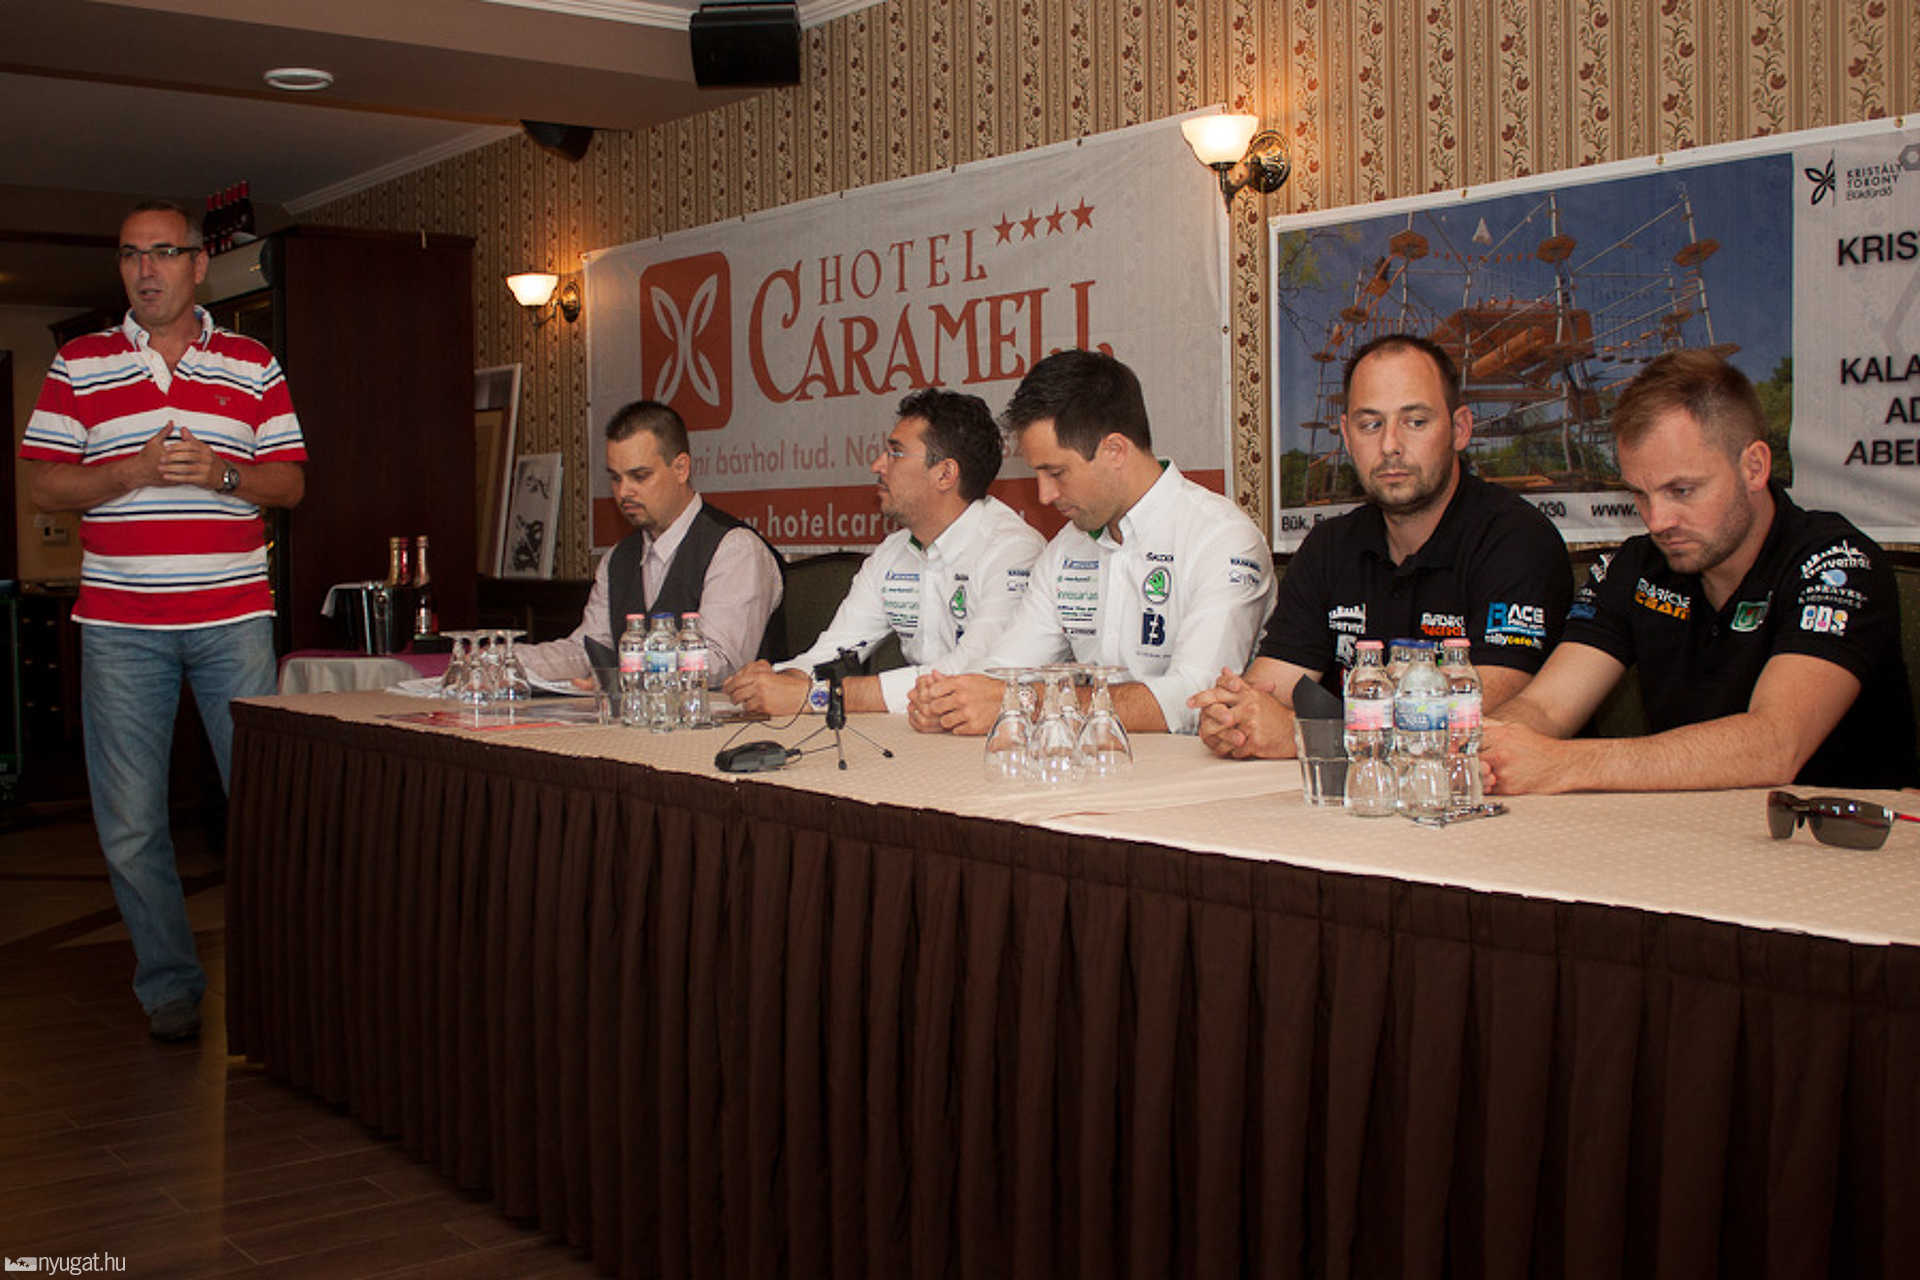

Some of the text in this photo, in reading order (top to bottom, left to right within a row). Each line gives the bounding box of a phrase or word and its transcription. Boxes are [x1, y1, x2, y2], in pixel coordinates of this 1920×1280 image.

[818, 228, 988, 306] HOTEL
[1837, 231, 1920, 267] KRIS
[747, 260, 1114, 404] CARAMELL
[716, 439, 785, 475] bárhol
[793, 433, 835, 470] tud.
[1844, 438, 1920, 466] ABE
